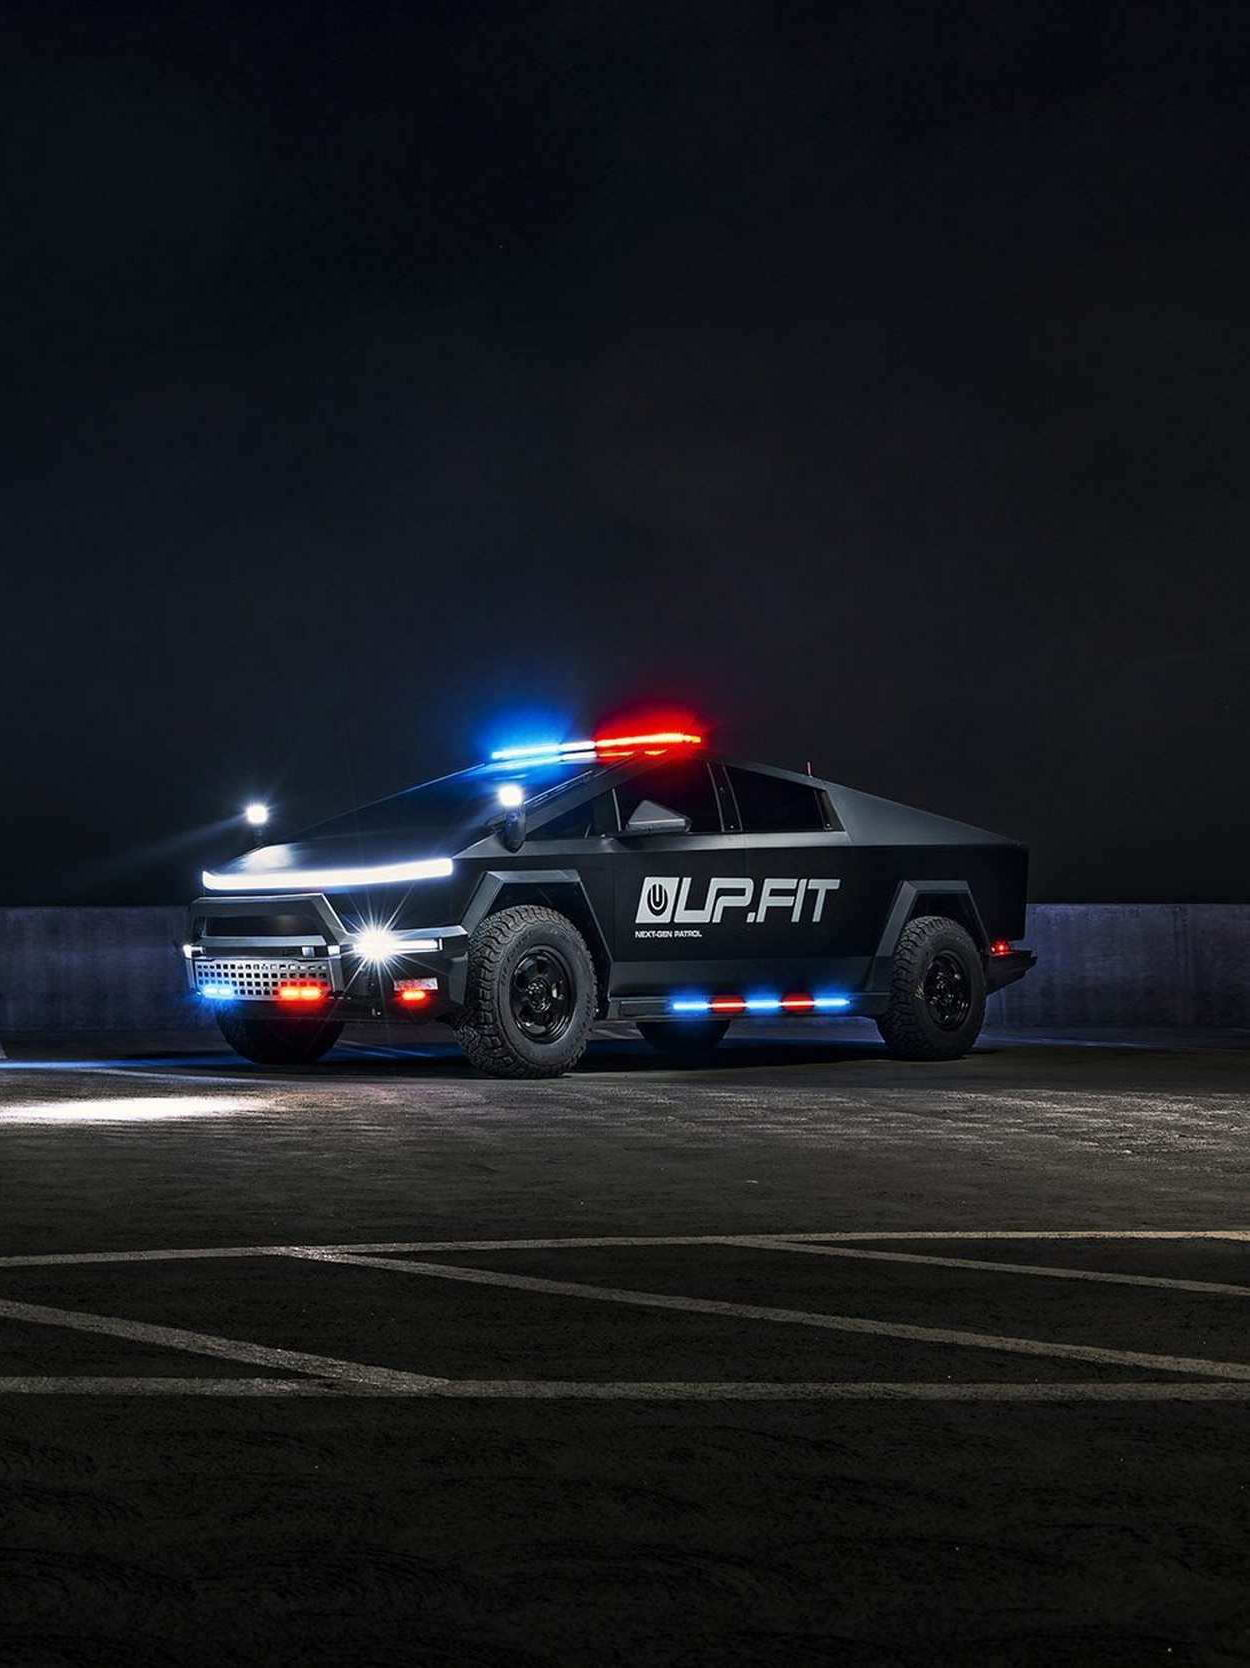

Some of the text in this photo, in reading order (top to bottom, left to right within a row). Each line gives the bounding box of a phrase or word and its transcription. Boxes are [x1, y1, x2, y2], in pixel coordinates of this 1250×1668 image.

[674, 877, 841, 923] UP.FIT
[635, 930, 703, 938] NEXT-GEN PATROL
